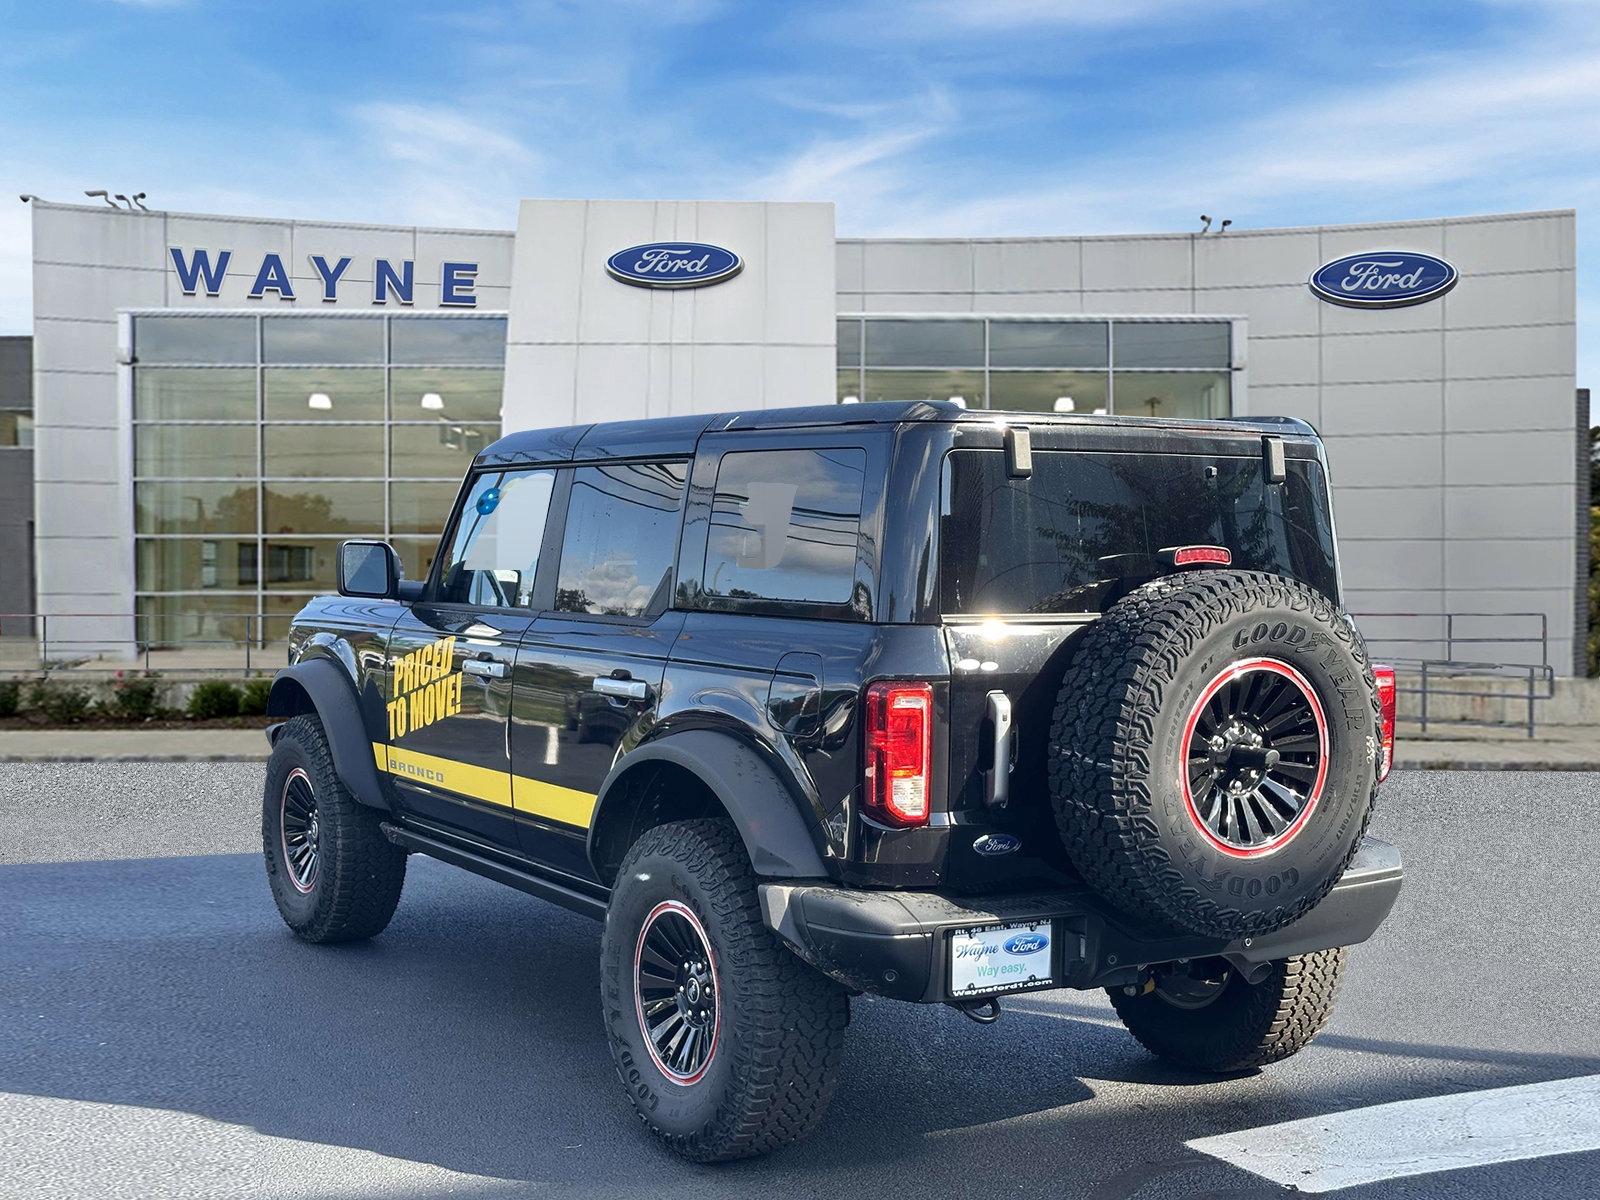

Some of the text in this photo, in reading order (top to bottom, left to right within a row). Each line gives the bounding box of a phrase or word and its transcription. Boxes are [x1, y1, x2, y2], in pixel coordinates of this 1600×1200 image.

[634, 249, 711, 273] Ford
[169, 247, 479, 305] WAYNE
[1341, 261, 1425, 291] Ford
[394, 635, 457, 699] PRICED
[387, 671, 463, 741] TO MOVE!
[389, 758, 445, 783] BRONCO
[985, 838, 1011, 852] Ford
[1009, 921, 1038, 929] Wayne
[955, 941, 999, 962] Wayne
[1011, 936, 1040, 952] Ford
[977, 963, 1027, 978] Way easy.
[953, 979, 1053, 997] Wayneford1.com
